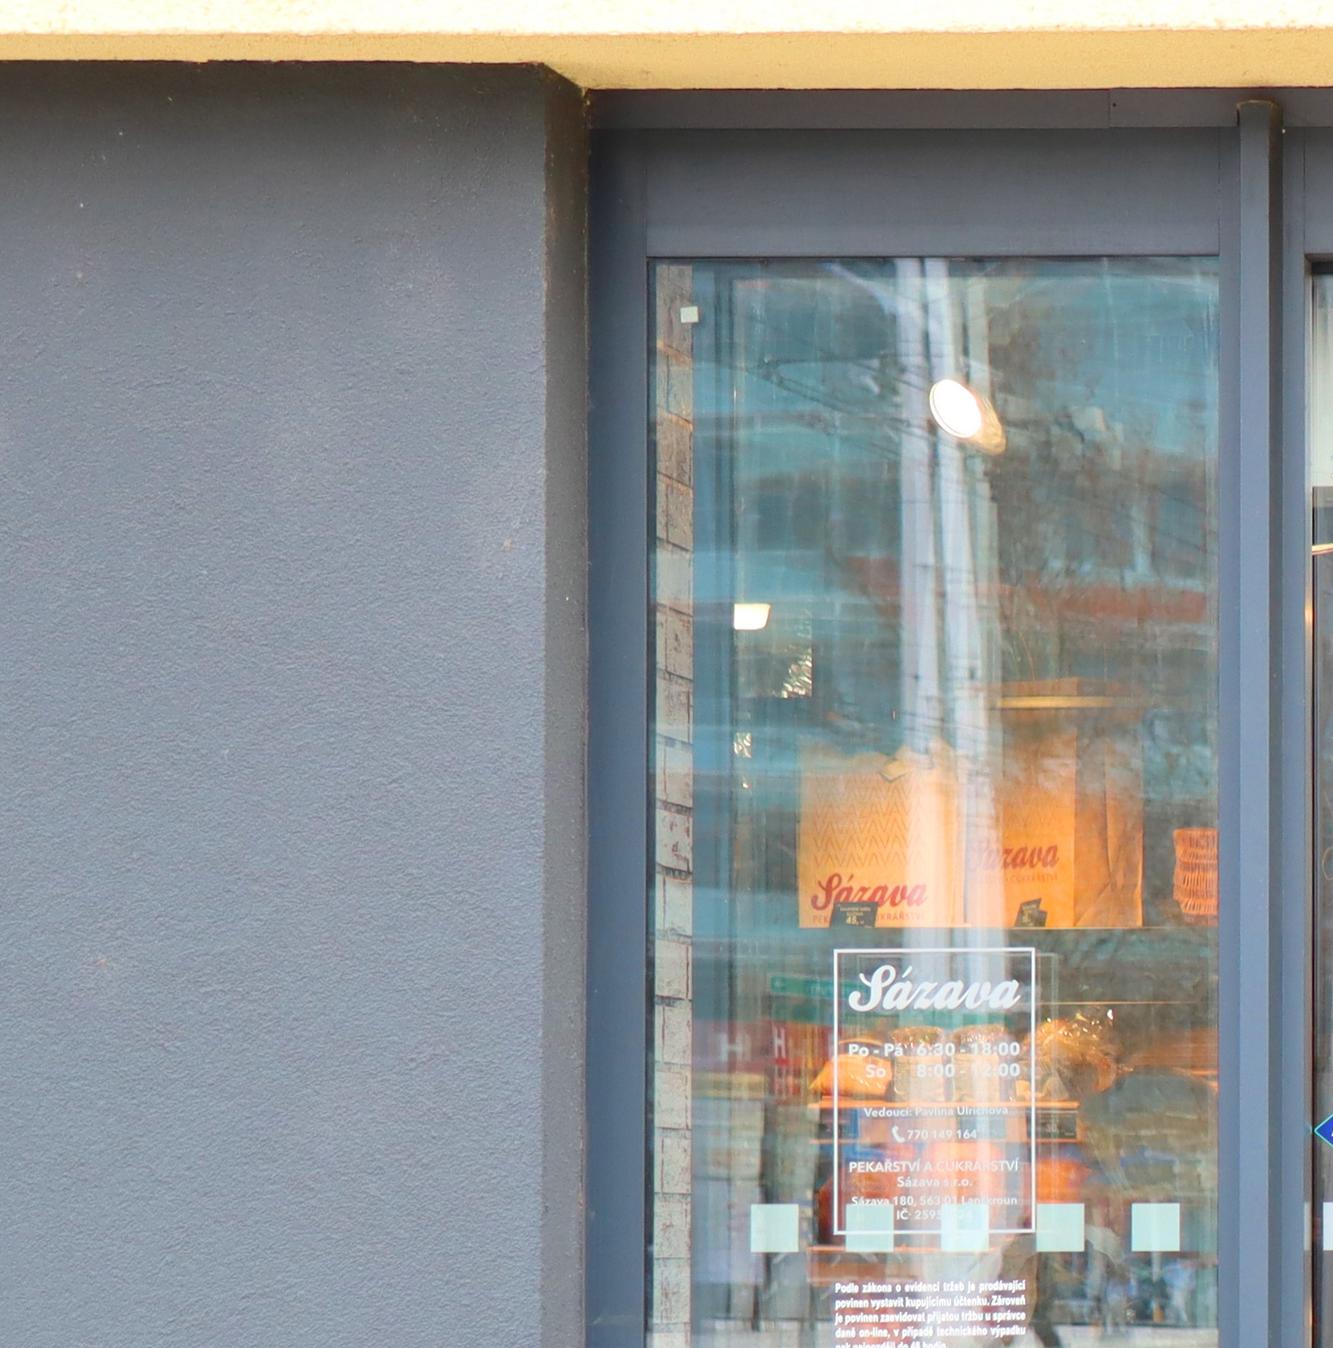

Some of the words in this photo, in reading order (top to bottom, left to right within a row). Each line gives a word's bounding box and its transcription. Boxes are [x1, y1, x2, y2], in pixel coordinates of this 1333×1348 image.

[848, 964, 1021, 1012] Sázava
[848, 1043, 869, 1057] Po
[884, 1042, 904, 1056] Pá
[916, 1043, 955, 1056] 6:30
[972, 1041, 1020, 1056] 18:00
[866, 1064, 887, 1078] So
[917, 1063, 955, 1077] 8:00
[907, 1129, 929, 1141] 770
[957, 1129, 977, 1140] 164
[848, 1158, 921, 1173] PEKAŘSTVÍ
[897, 1175, 940, 1188] Sázava
[835, 1283, 859, 1293] Podle
[862, 1282, 892, 1293] zákona
[896, 1285, 901, 1293] o
[904, 1281, 940, 1293] evidenci
[943, 1281, 965, 1292] tržeb
[967, 1281, 976, 1294] je
[978, 1280, 1026, 1293] prodávající
[835, 1298, 869, 1309] povinen
[870, 1297, 904, 1310] vystavit
[905, 1296, 951, 1309] kupujícímu
[953, 1296, 990, 1307] účtenku.
[991, 1295, 1026, 1306] Zároveň
[835, 1313, 844, 1325] je
[845, 1312, 879, 1324] povinen
[880, 1312, 926, 1323] zaevidovat
[927, 1311, 960, 1324] přijatou
[961, 1311, 983, 1321] tržbu
[992, 1310, 1026, 1322] správce
[835, 1327, 856, 1338] daně
[859, 1327, 891, 1339] on-line,
[902, 1327, 934, 1339] případě
[936, 1326, 988, 1337] technického
[990, 1325, 1026, 1338] výpadku
